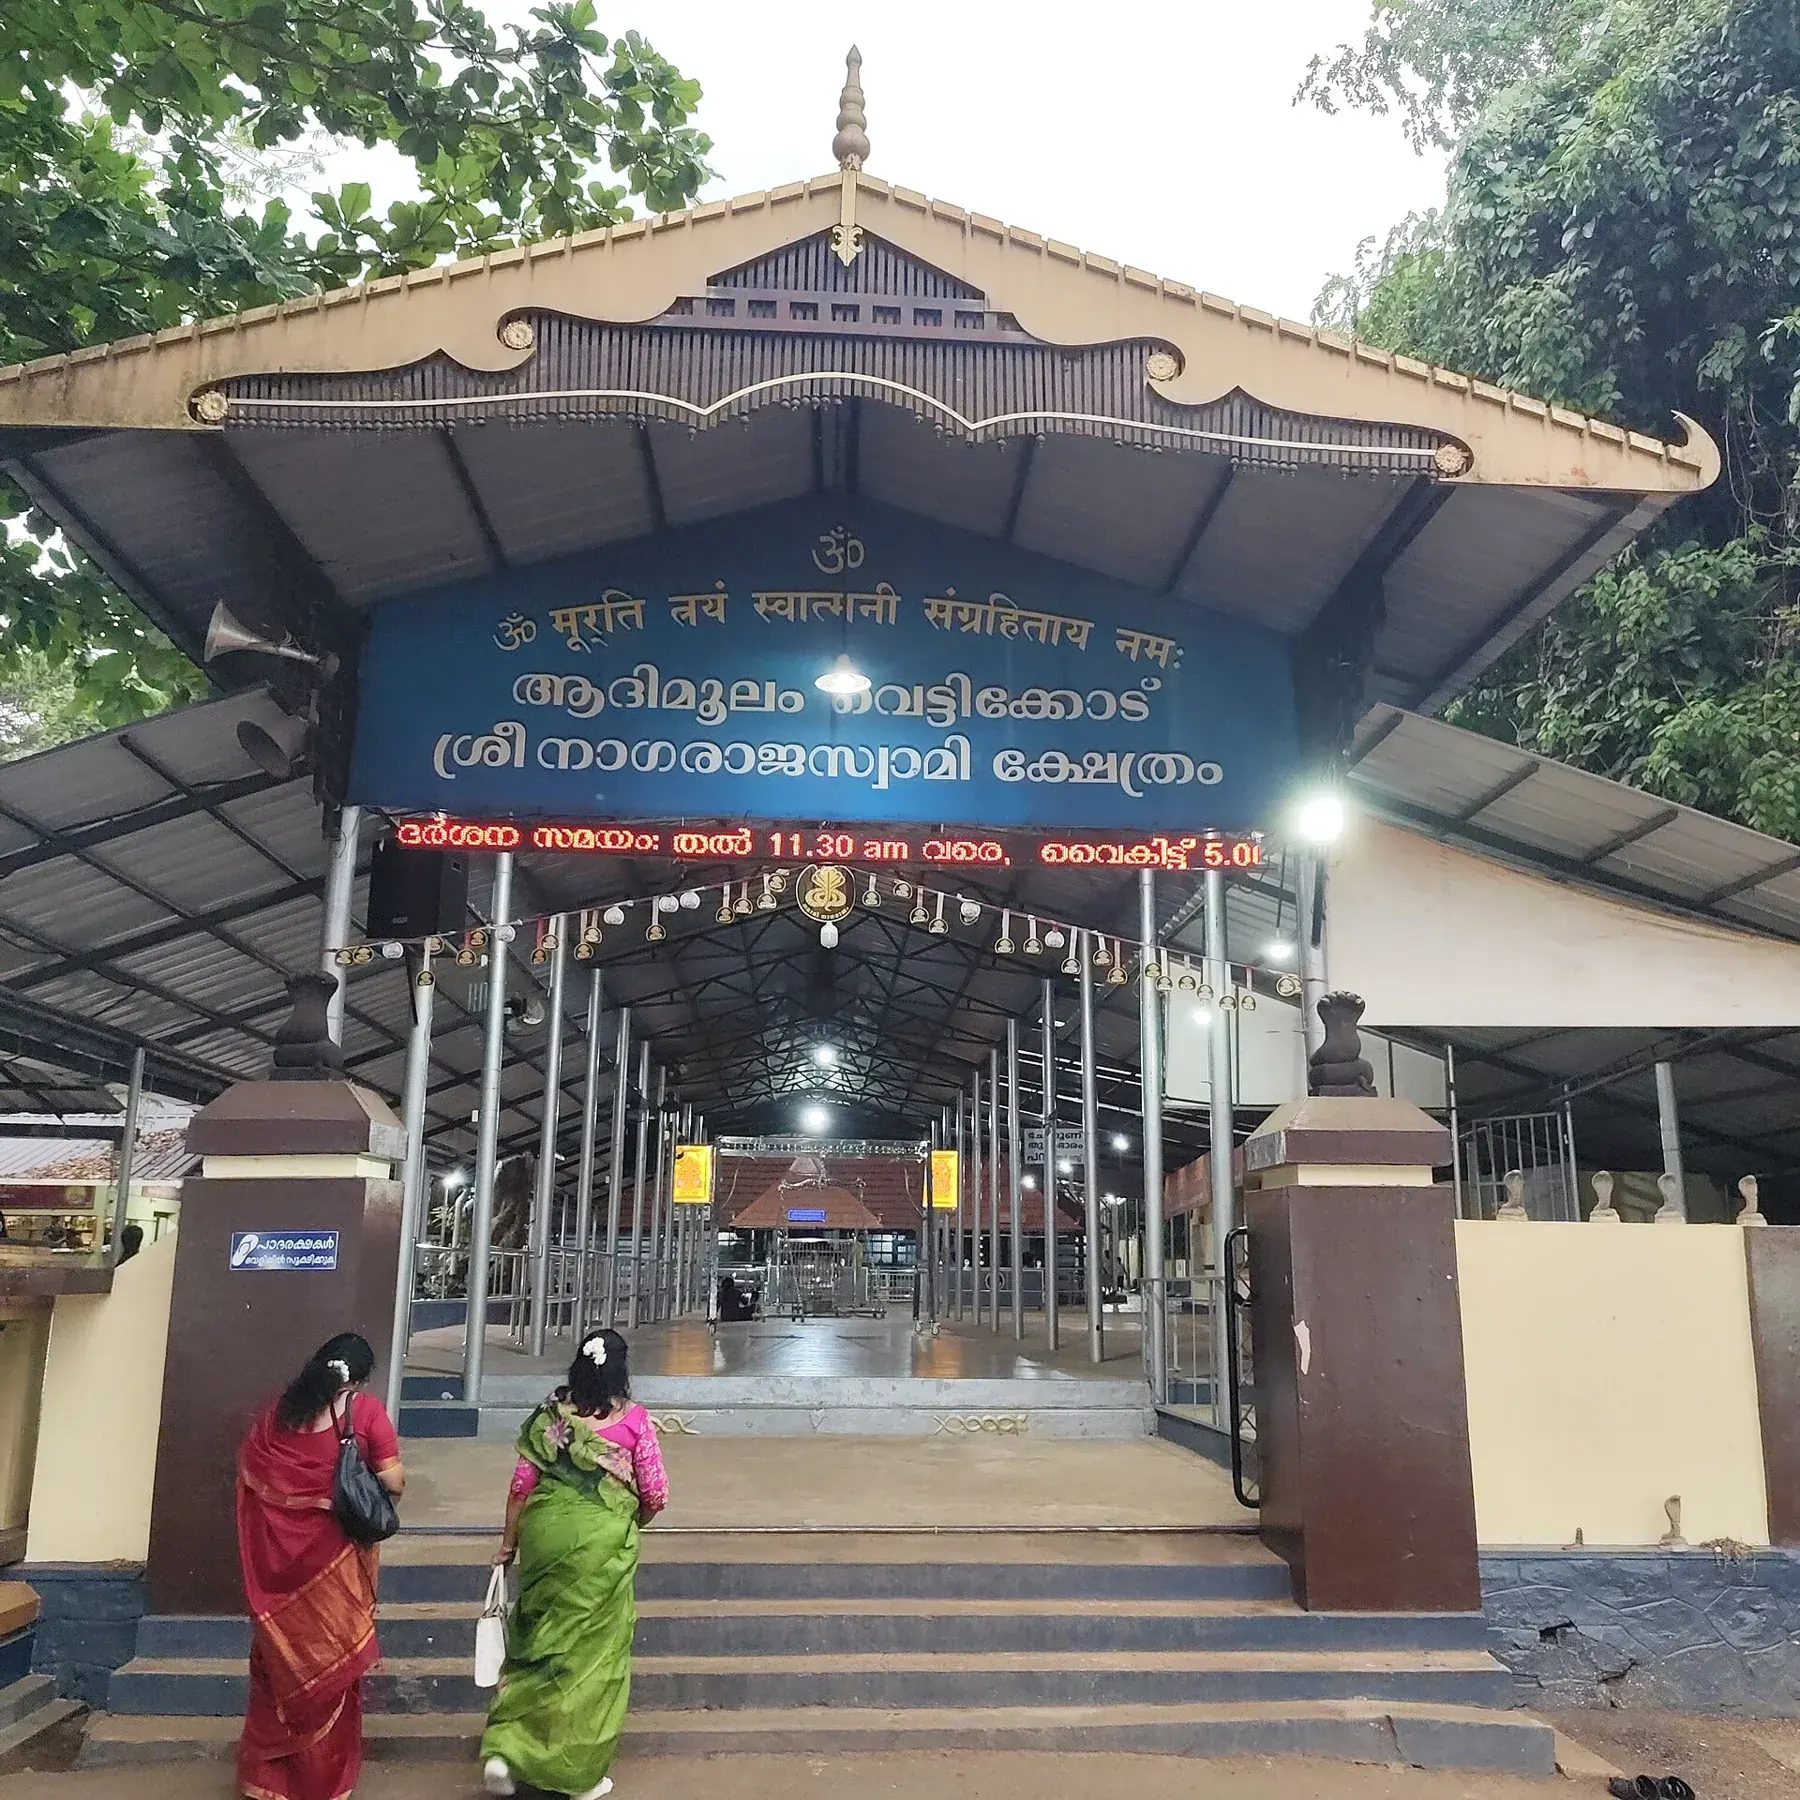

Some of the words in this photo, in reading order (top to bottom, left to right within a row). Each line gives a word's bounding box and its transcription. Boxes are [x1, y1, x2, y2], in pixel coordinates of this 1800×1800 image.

[512, 663, 805, 727] ആദിമൂലം
[433, 721, 526, 780] ശ്രീ
[536, 732, 972, 790] നാഗരാജസ്വാമി
[992, 748, 1224, 799] ക്ഷേത്രം
[769, 831, 855, 858] 11.30
[863, 839, 909, 860] am
[257, 1235, 335, 1250] പാദരക്ഷകൾ
